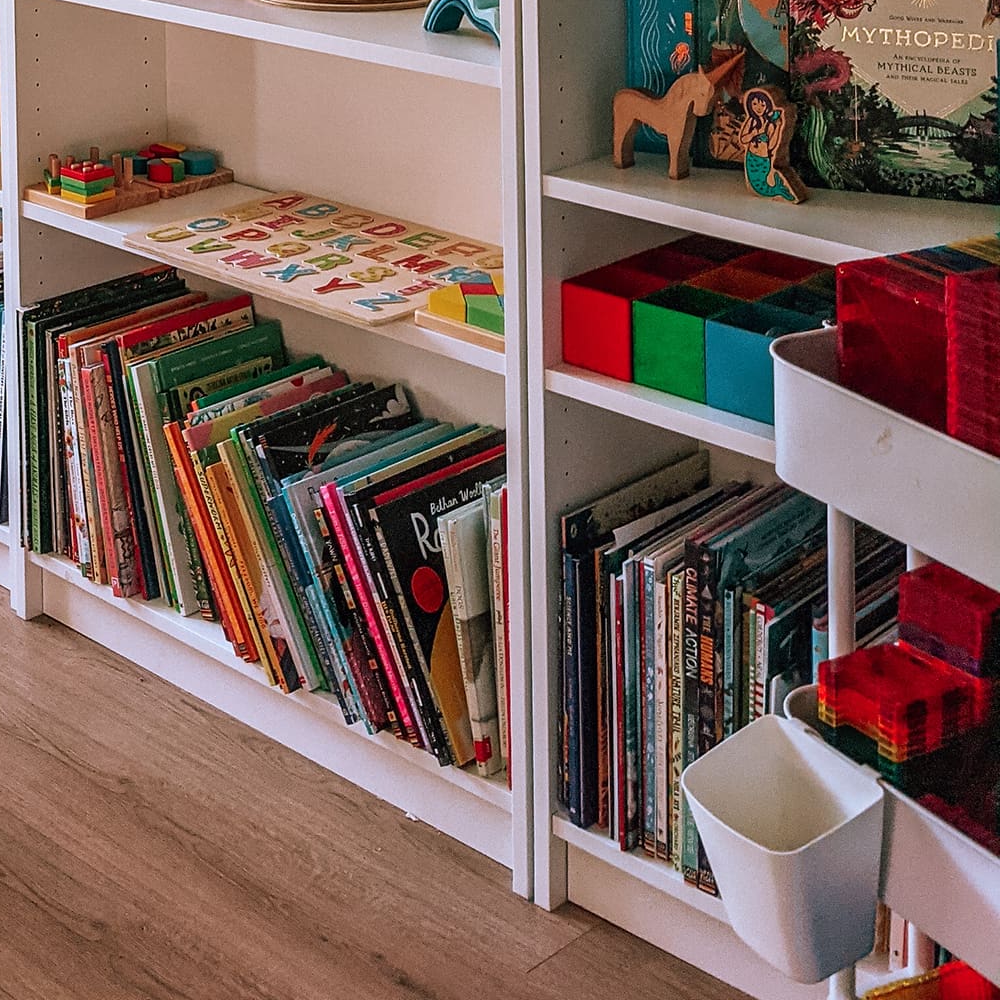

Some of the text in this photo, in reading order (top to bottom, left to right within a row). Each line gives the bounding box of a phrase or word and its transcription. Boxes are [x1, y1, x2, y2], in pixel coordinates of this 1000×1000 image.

[840, 25, 994, 52] MYTHOPEDI
[877, 62, 977, 77] MYTHICAL BEASTS
[198, 471, 222, 531] SUPERWORM
[430, 496, 458, 515] Bethan
[325, 540, 338, 563] YAWN
[685, 567, 698, 679] CLIMATE ACTION
[700, 634, 714, 686] HUMANS
